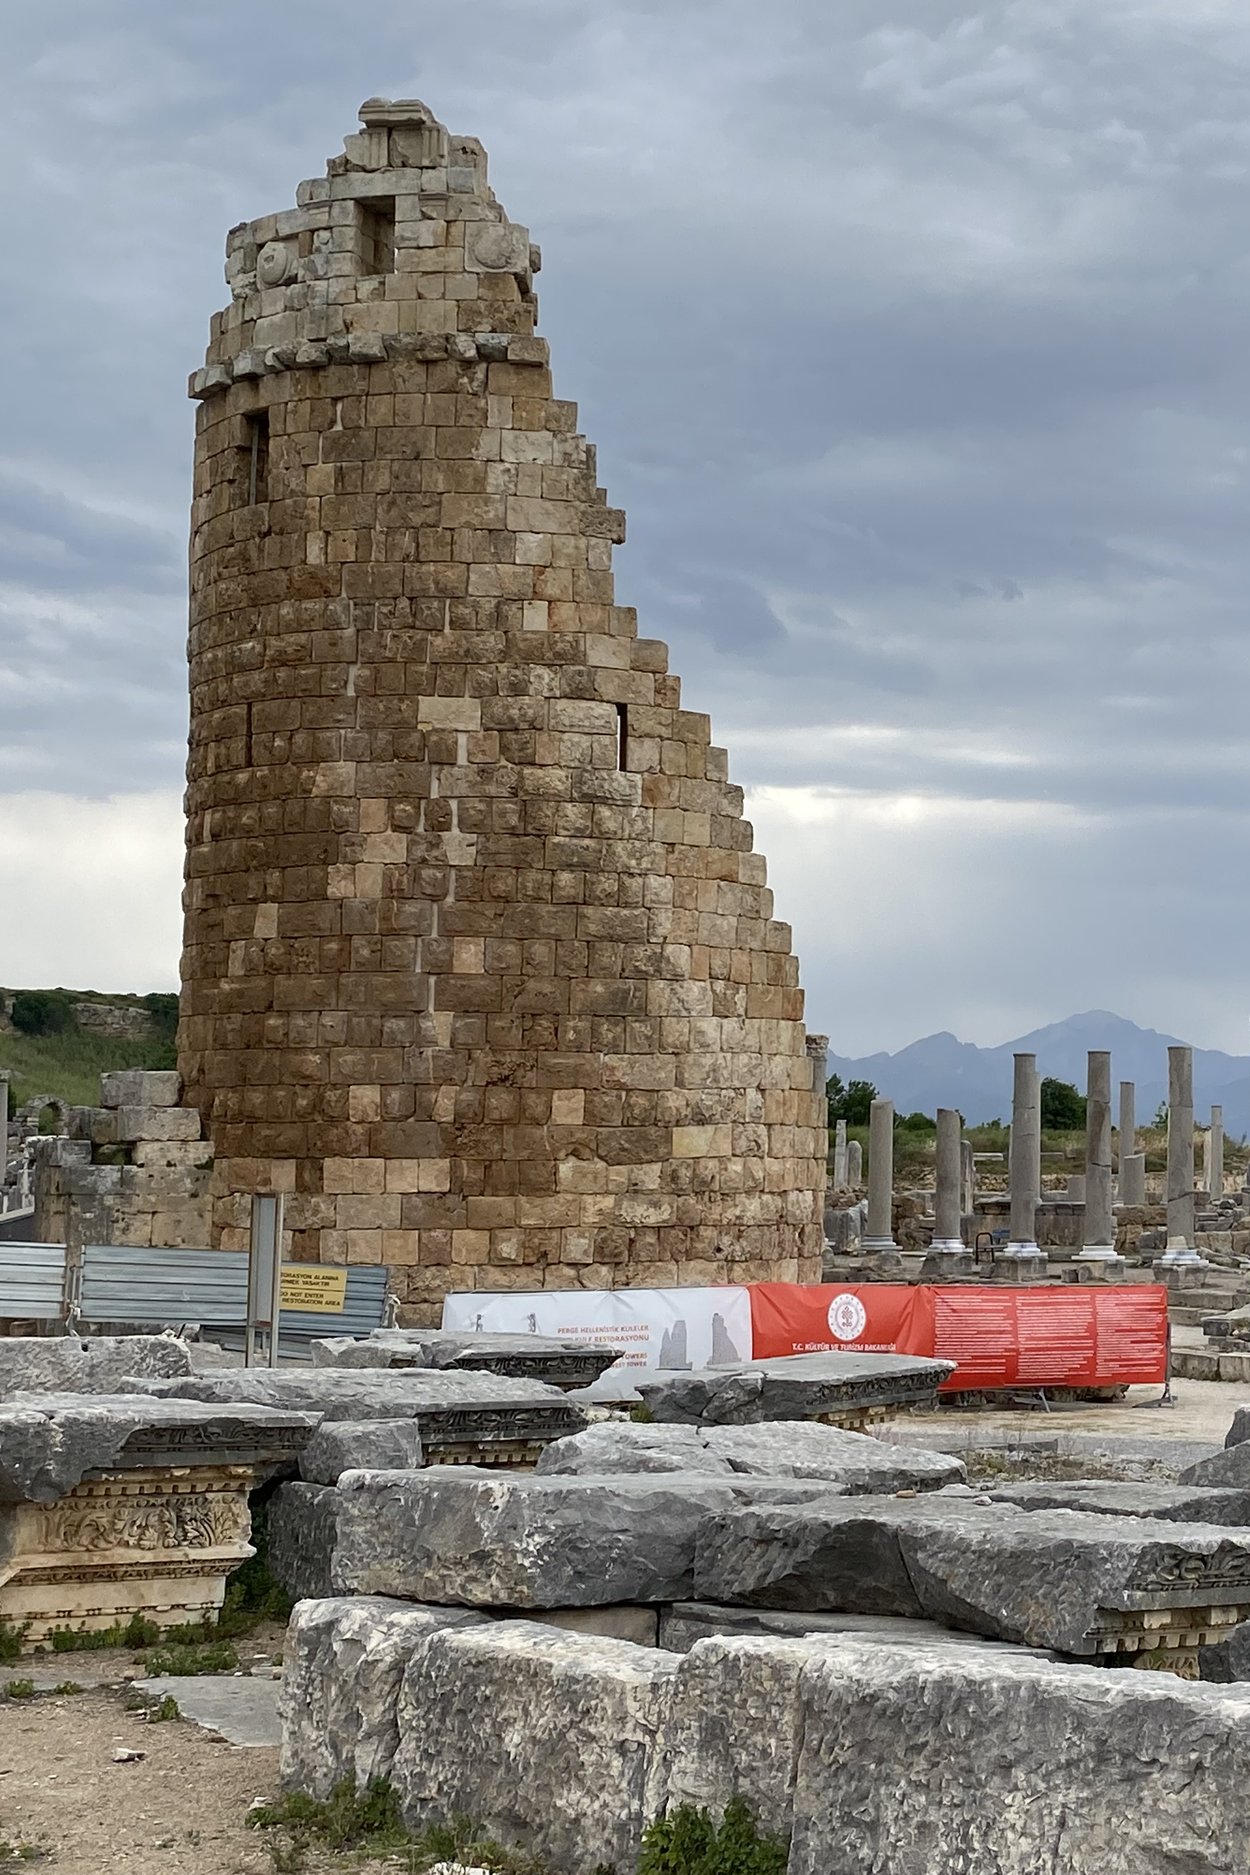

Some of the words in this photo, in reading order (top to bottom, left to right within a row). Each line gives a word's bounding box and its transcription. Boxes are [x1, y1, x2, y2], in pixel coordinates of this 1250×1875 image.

[792, 1343, 803, 1351] T.C.
[805, 1342, 829, 1351] KÜLTÜR
[831, 1343, 839, 1351] VE
[840, 1342, 864, 1351] TURİZM
[864, 1342, 896, 1351] BAKANLIĞI
